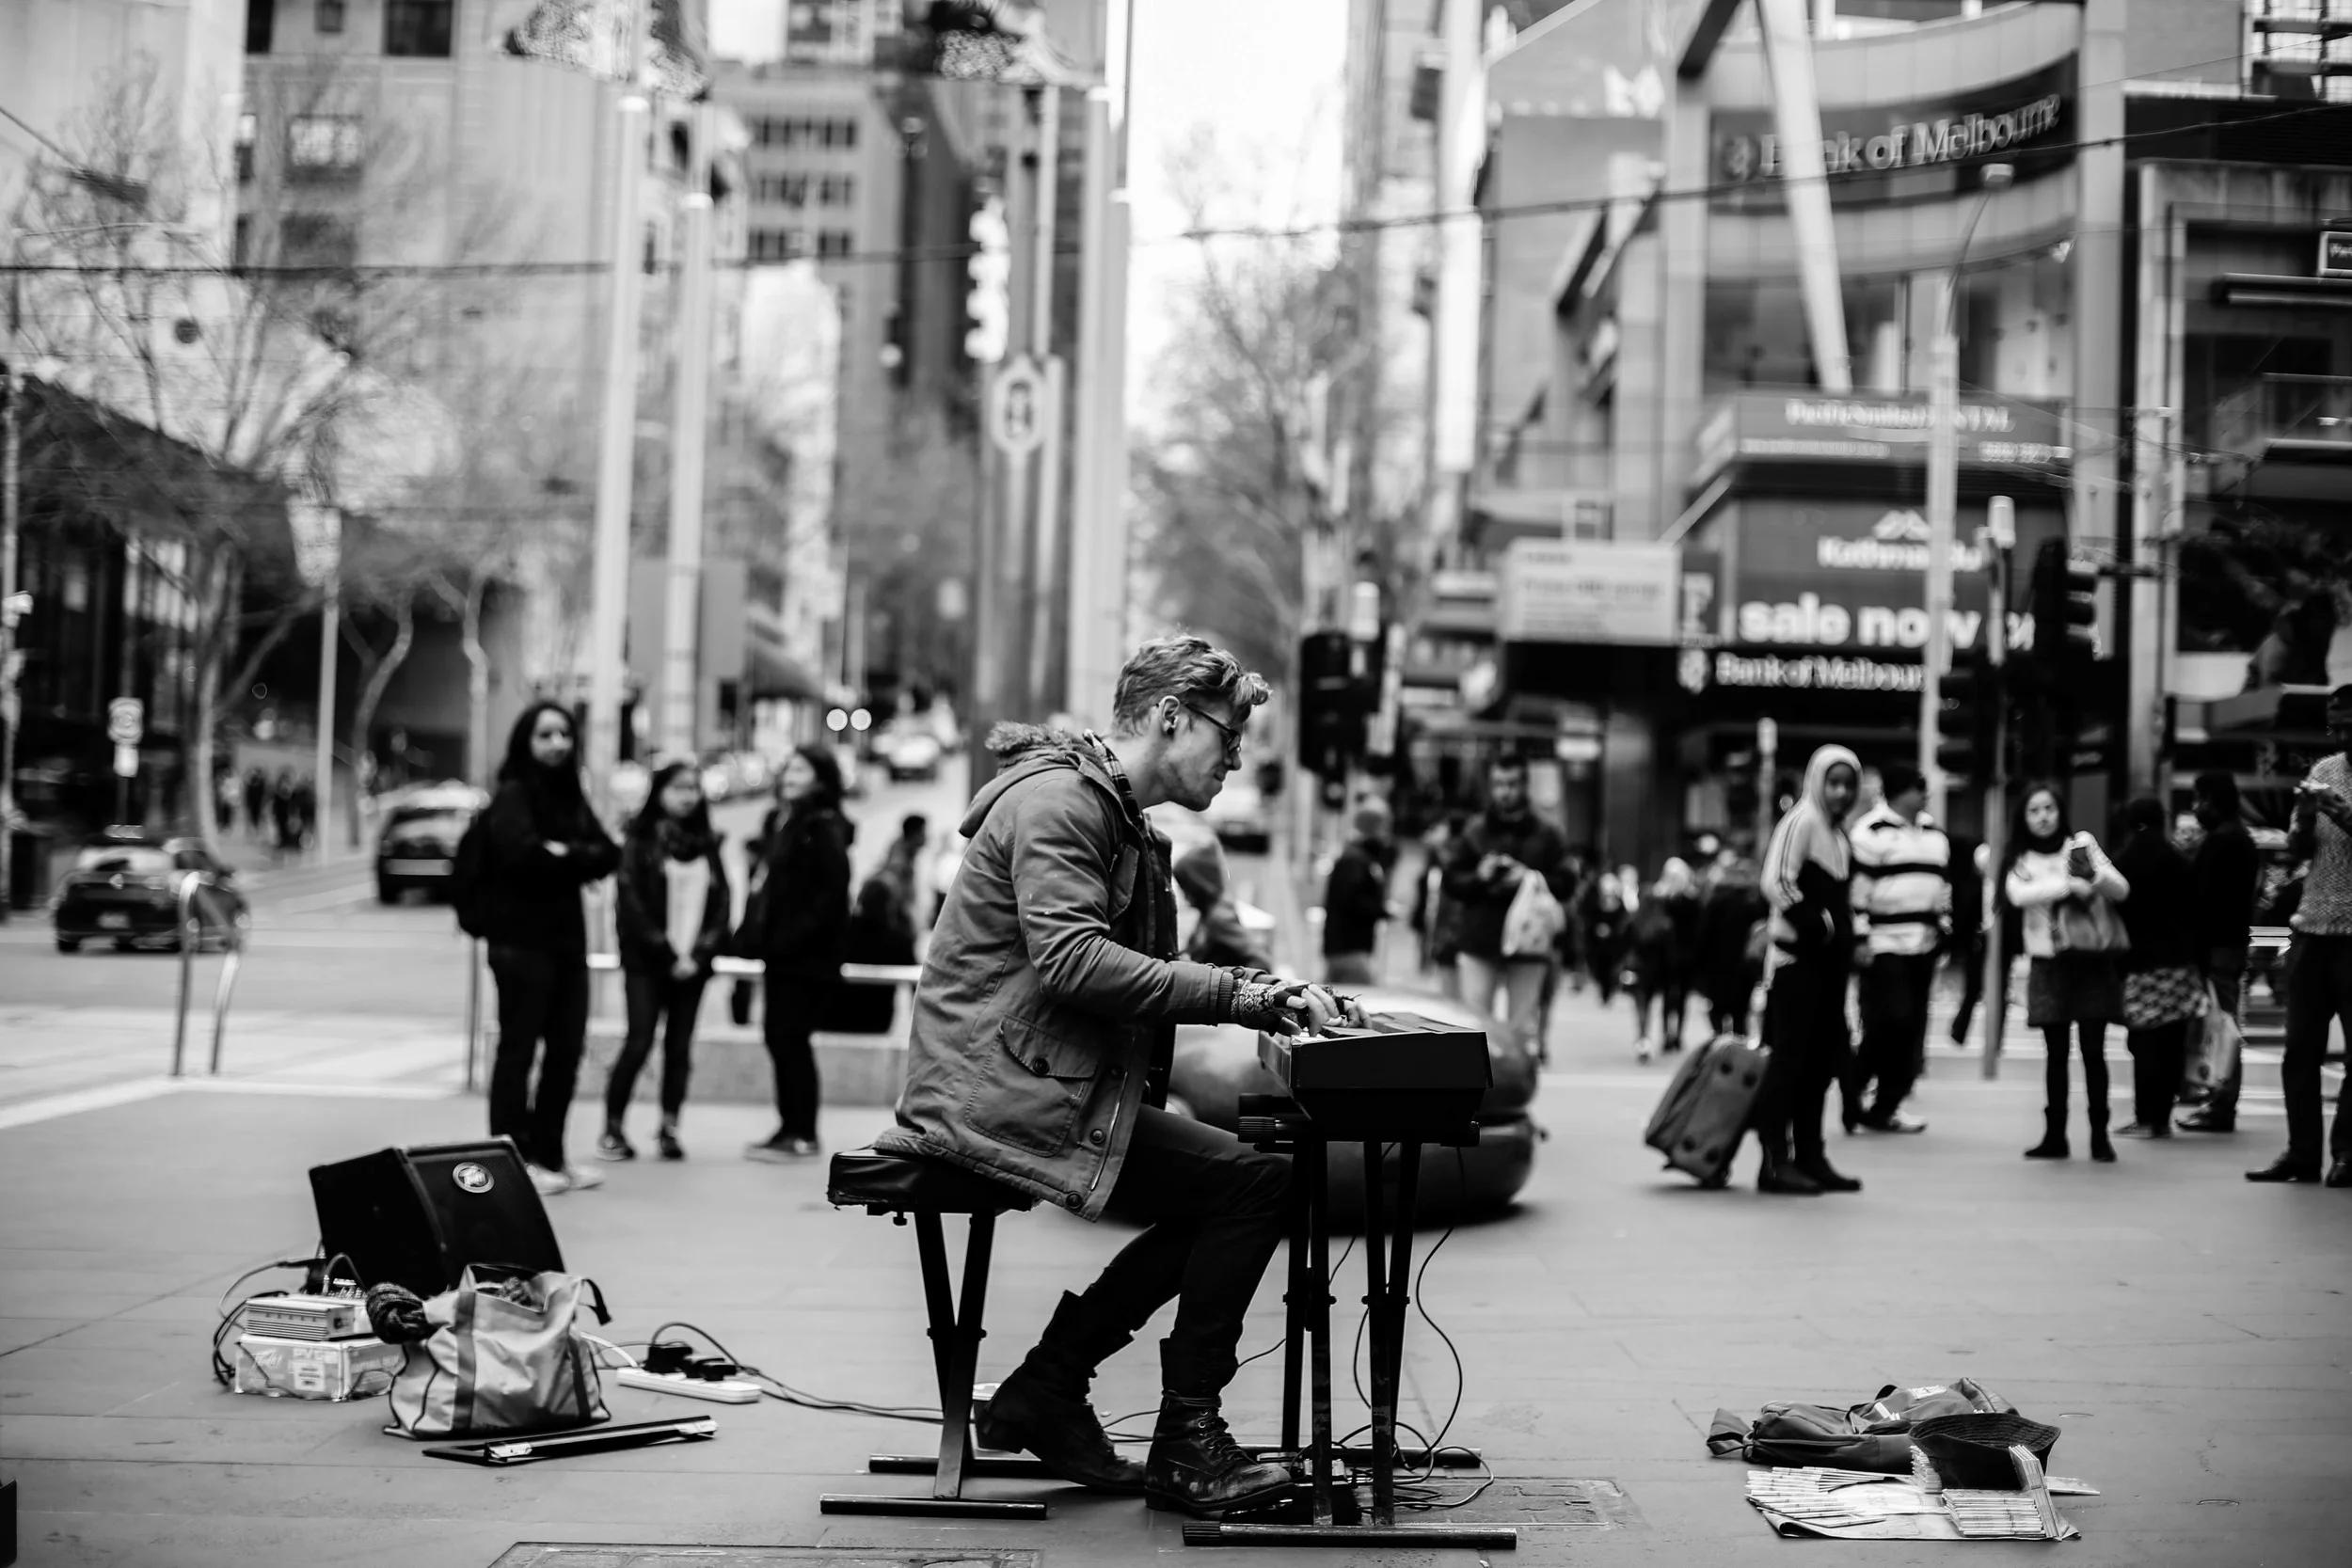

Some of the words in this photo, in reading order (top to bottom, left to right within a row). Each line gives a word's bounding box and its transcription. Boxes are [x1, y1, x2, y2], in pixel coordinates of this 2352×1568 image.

[1759, 130, 1864, 177] Bnk
[1865, 124, 1910, 169] of
[1908, 94, 2060, 165] Melbourne
[1818, 536, 1981, 572] Kathmadu
[1740, 592, 1851, 646] sale
[1857, 606, 1981, 649] now
[1716, 652, 1785, 688] Bank
